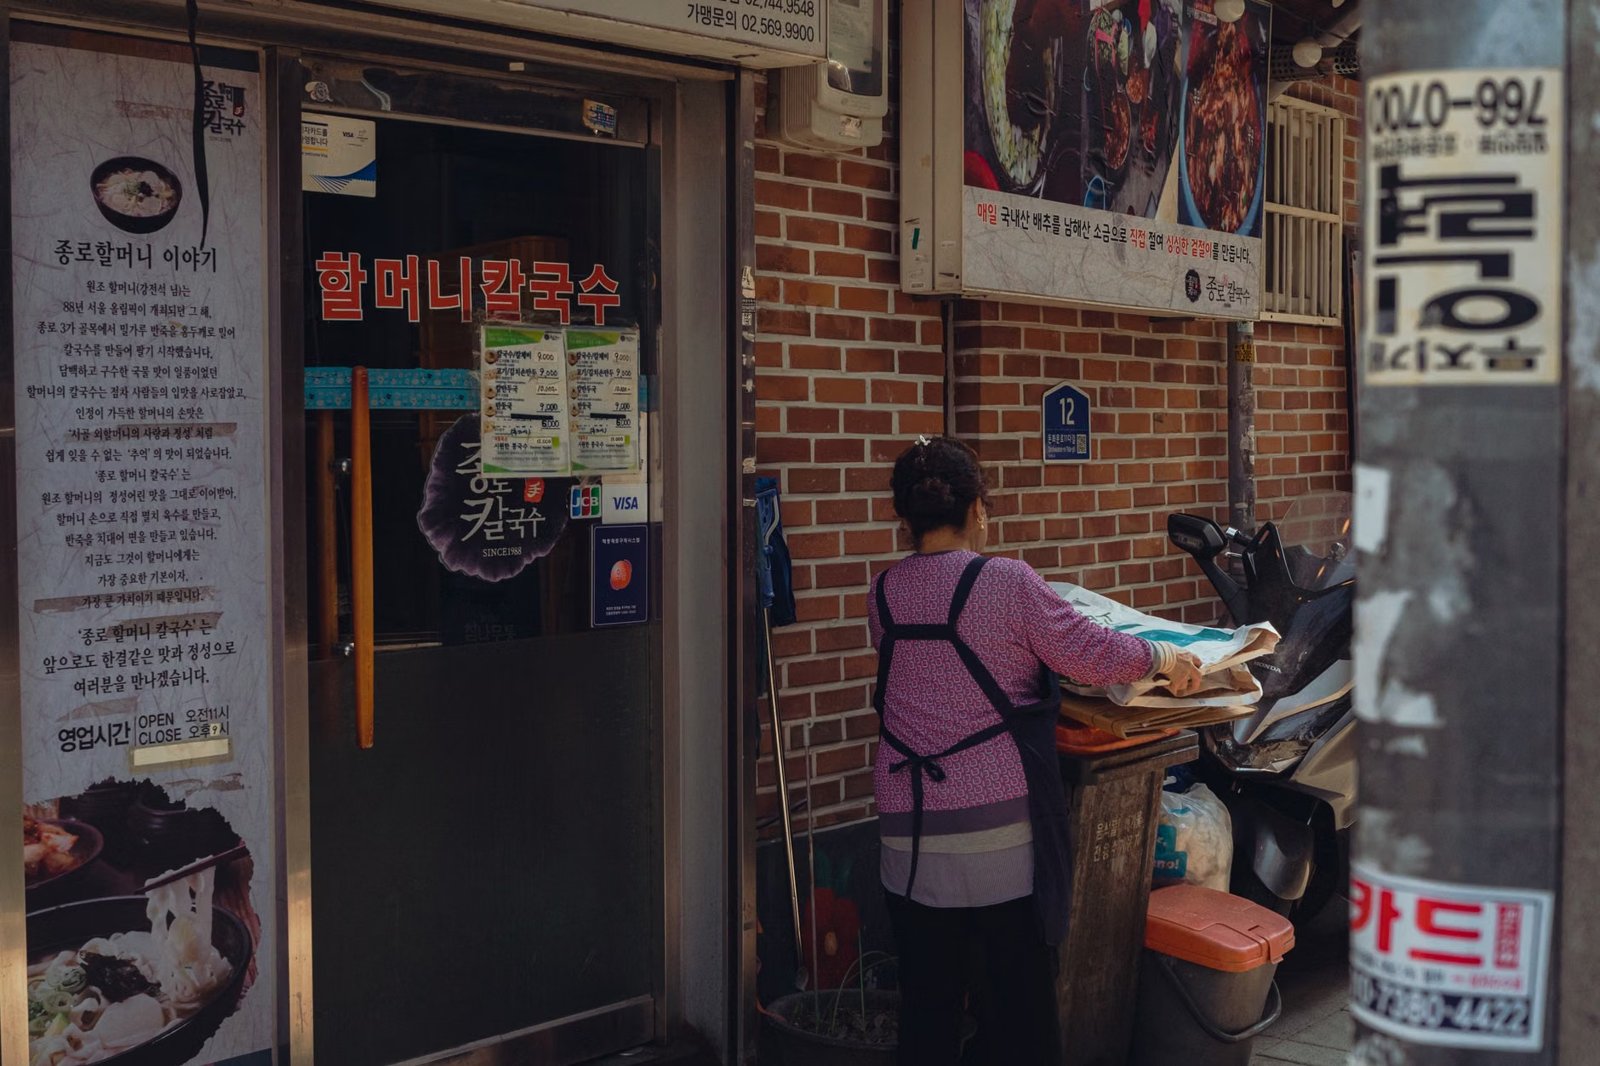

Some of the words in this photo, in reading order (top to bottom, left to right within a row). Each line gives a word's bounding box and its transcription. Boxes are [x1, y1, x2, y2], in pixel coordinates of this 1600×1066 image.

[687, 3, 737, 30] 가맹문의
[742, 14, 814, 42] 02.569.9900
[302, 126, 328, 137] 자카드를
[977, 203, 997, 225] 매일
[1001, 206, 1030, 230] 국내산
[1032, 212, 1061, 235] 배추를
[1064, 217, 1091, 240] 남해산
[1093, 224, 1127, 243] 소금으로
[1130, 228, 1146, 249] 직접
[1148, 231, 1164, 251] 절여
[1166, 235, 1189, 256] 싱싱한
[1191, 238, 1219, 260] 겉절이를
[1221, 244, 1252, 264] 만듭니다.
[54, 240, 152, 269] 종로할머니
[163, 245, 217, 272] 이야기
[86, 280, 105, 293] 원조
[170, 284, 191, 297] 님)는
[316, 251, 620, 325] 할머니칼국수
[1206, 275, 1226, 301] 종로
[1227, 281, 1250, 305] 칼국수
[63, 301, 84, 314] 88년
[88, 301, 106, 315] 서울
[110, 302, 146, 316] 올림픽이
[150, 304, 185, 317] 개최되던
[188, 307, 198, 316] 그
[38, 321, 57, 334] 종로
[60, 322, 76, 335] 3가
[79, 322, 116, 336] 골목에서
[120, 323, 148, 337] 밀가루
[150, 324, 178, 338] 반죽을
[219, 327, 236, 339] 밀어
[64, 343, 101, 357] 칼국수를
[104, 343, 133, 358] 만들어
[136, 344, 154, 358] 팔기
[157, 345, 213, 359] 시작했습니다.
[59, 364, 97, 378] 담백하고
[100, 365, 128, 378] 구수한
[131, 365, 150, 379] 국물
[153, 365, 171, 379] 맛이
[173, 366, 217, 379] 일품이었던
[27, 385, 66, 399] 할머니의
[69, 385, 108, 399] 칼국수는
[111, 386, 129, 399] 점차
[132, 386, 168, 399] 사람들의
[171, 386, 198, 399] 입맛을
[200, 386, 247, 400] 사로잡았고,
[75, 406, 104, 420] 인정이
[107, 406, 135, 420] 가득한
[138, 407, 174, 420] 할머니의
[177, 407, 204, 420] 손맛은
[1060, 398, 1075, 425] 12
[94, 427, 140, 441] 외할머니의
[143, 427, 170, 441] 사랑과
[196, 426, 213, 440] 처럼
[45, 449, 65, 463] 쉽게
[68, 449, 87, 462] 잊을
[90, 449, 100, 461] 수
[103, 448, 123, 462] 없는
[153, 447, 162, 461] 의
[165, 447, 183, 461] 맛이
[186, 447, 232, 460] 되었습니다.
[120, 468, 146, 483] 할머니
[181, 469, 192, 480] 는
[41, 492, 62, 505] 원조
[64, 490, 102, 505] 할머니의
[109, 489, 146, 504] 정성어린
[148, 488, 167, 502] 맛을
[170, 488, 197, 501] 그대로
[572, 496, 599, 508] JCB
[613, 496, 639, 510] VISA
[56, 512, 85, 526] 할머니
[89, 512, 117, 525] 손으로
[120, 510, 138, 524] 직접
[141, 509, 159, 523] 멸치
[163, 508, 190, 522] 육수를
[460, 495, 546, 542] 칼국수
[65, 533, 94, 547] 반죽을
[97, 531, 125, 546] 치대어
[128, 530, 147, 544] 면을
[150, 529, 177, 543] 만들고
[180, 527, 217, 542] 있습니다.
[84, 553, 113, 567] 지금도
[116, 551, 143, 565] 그것이
[147, 549, 200, 564] 할머니에게는
[482, 547, 522, 557] SINCE1988
[97, 573, 116, 588] 가장
[119, 572, 147, 585] 중요한
[82, 595, 104, 609] 가장
[105, 595, 115, 607] 큰
[118, 592, 153, 607] 가치이기
[156, 588, 204, 603] 때문입니다.
[112, 622, 150, 643] 할머니
[200, 619, 212, 636] 는
[43, 651, 98, 674] 앞으로도
[101, 647, 154, 669] 한결같은
[158, 645, 183, 663] 맛과
[188, 641, 237, 661] 정성으로
[1254, 661, 1282, 674] HONDA
[74, 674, 127, 697] 여러분을
[131, 666, 210, 691] 만나겠습니다.
[138, 712, 174, 729] OPEN
[186, 705, 230, 723] 오전11시
[58, 721, 131, 753] 영업시간
[138, 728, 182, 746] CLOSE
